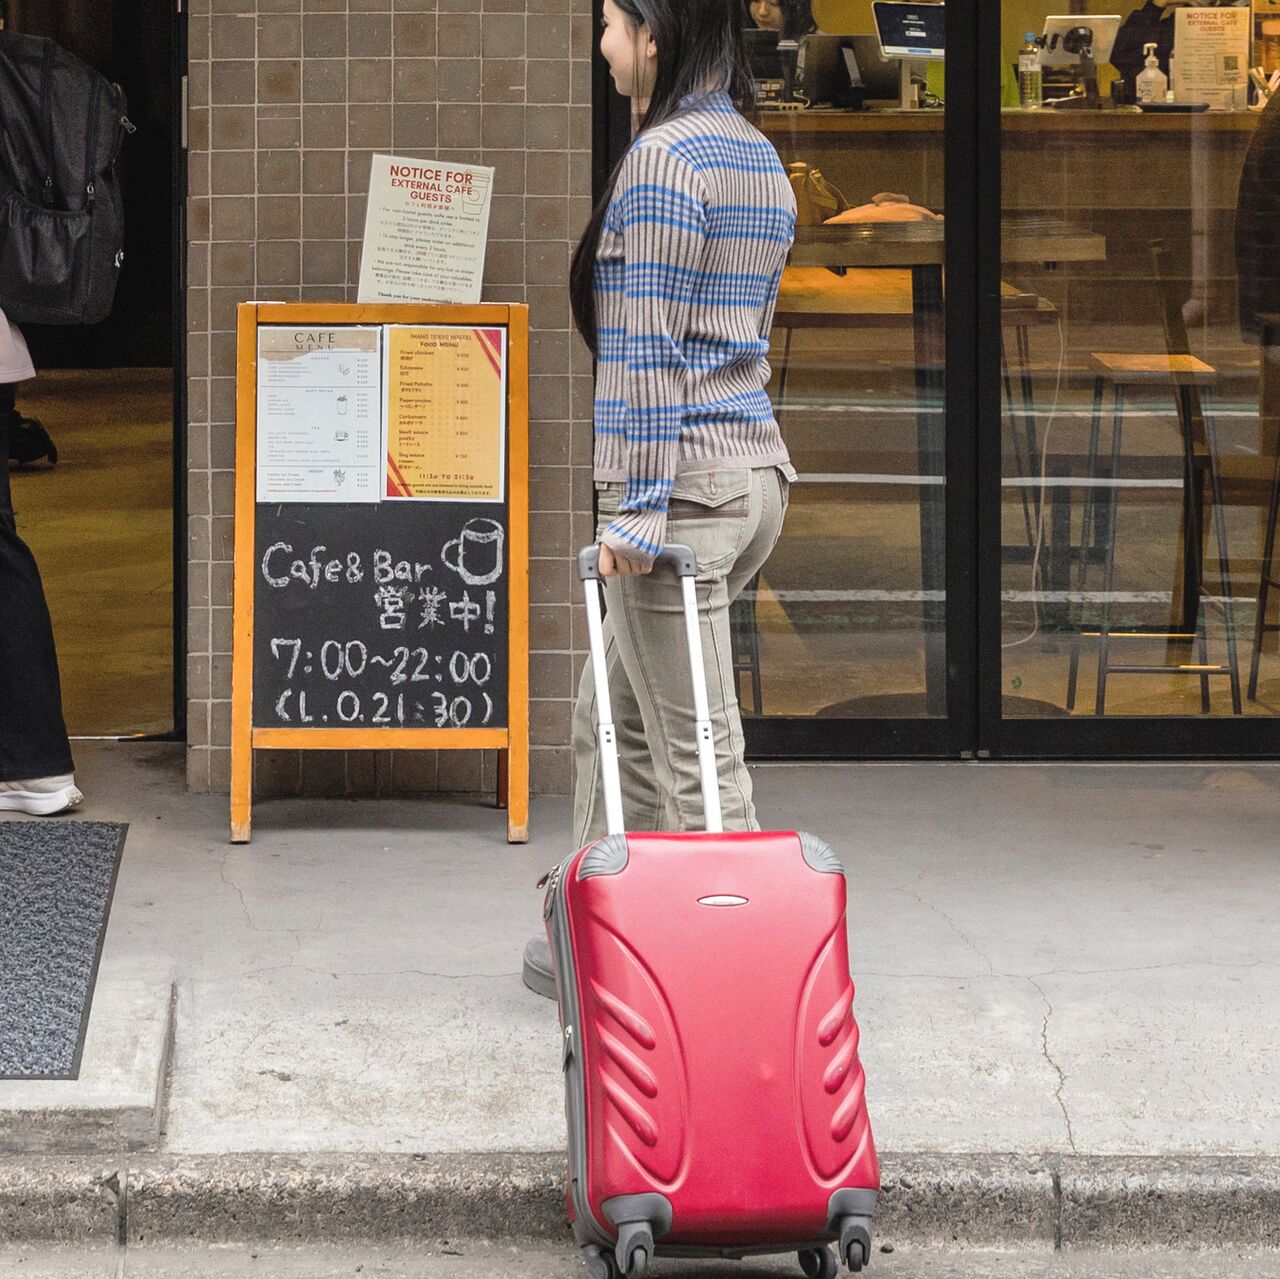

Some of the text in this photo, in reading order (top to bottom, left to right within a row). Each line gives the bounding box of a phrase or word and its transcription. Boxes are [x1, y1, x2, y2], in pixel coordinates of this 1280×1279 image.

[390, 166, 473, 184] NOTICE FOR
[391, 179, 473, 195] EXTERNAL CAFE
[410, 191, 451, 203] GUESTS
[295, 333, 335, 343] CAFE
[373, 549, 432, 583] Bar
